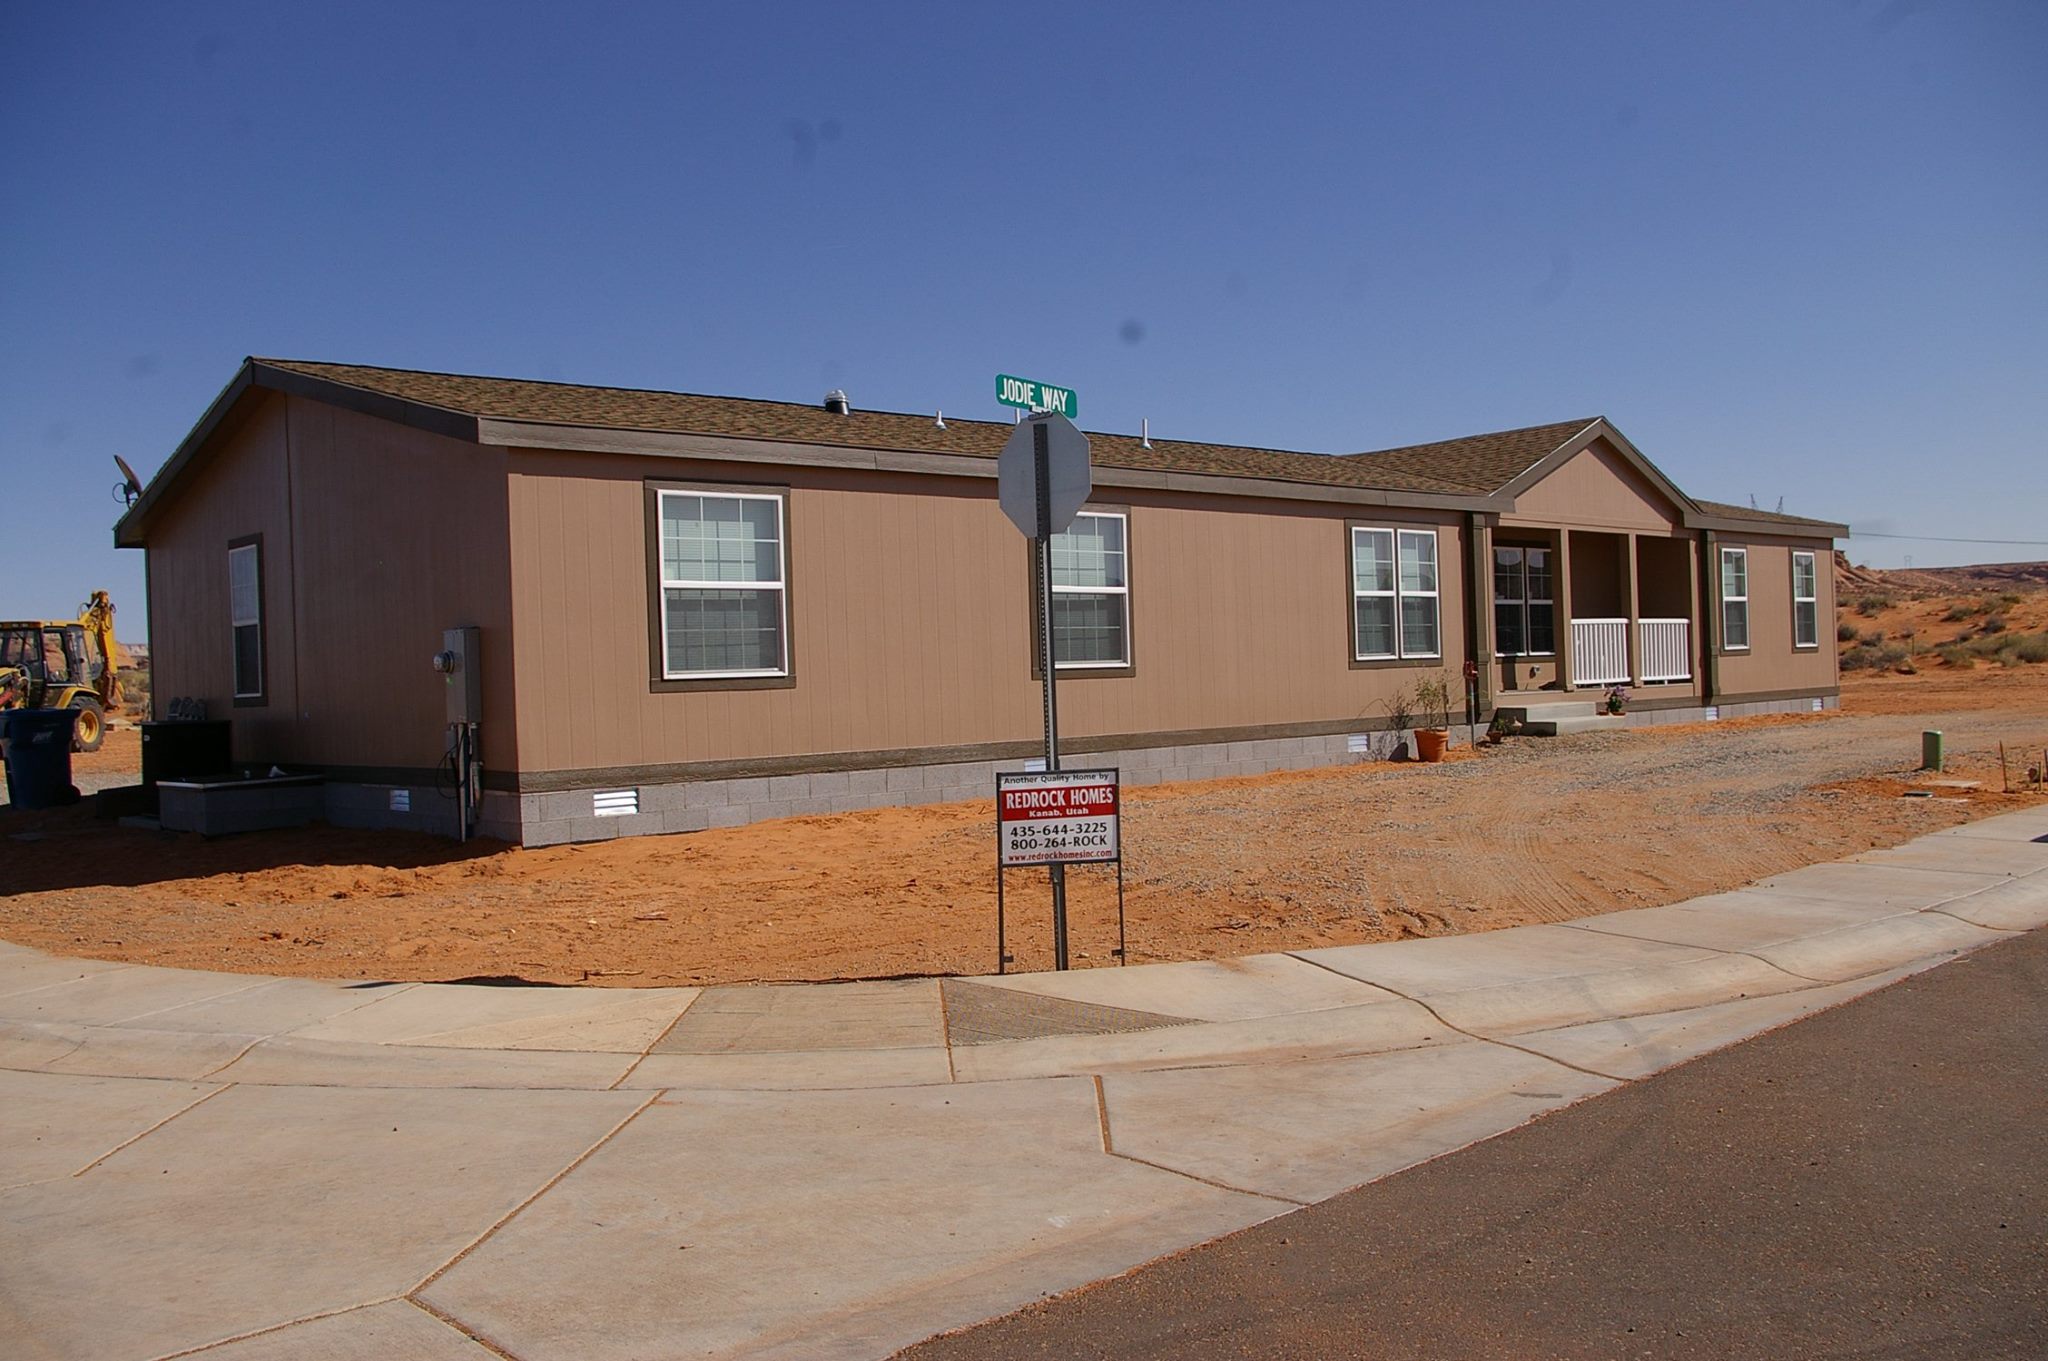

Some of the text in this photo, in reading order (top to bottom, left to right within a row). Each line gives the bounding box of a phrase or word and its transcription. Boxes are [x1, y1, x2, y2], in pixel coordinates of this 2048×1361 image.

[999, 378, 1068, 412] JODIE WAY
[1004, 776, 1038, 784] Another
[1041, 774, 1070, 782] Quality
[1006, 787, 1114, 809] REDROCK HOMES
[1066, 807, 1089, 815] Utah
[1010, 822, 1107, 837] 435-644-3225
[1011, 835, 1108, 850] 800-264-ROCK
[1008, 849, 1112, 861] www.redrockhomesinc.com
